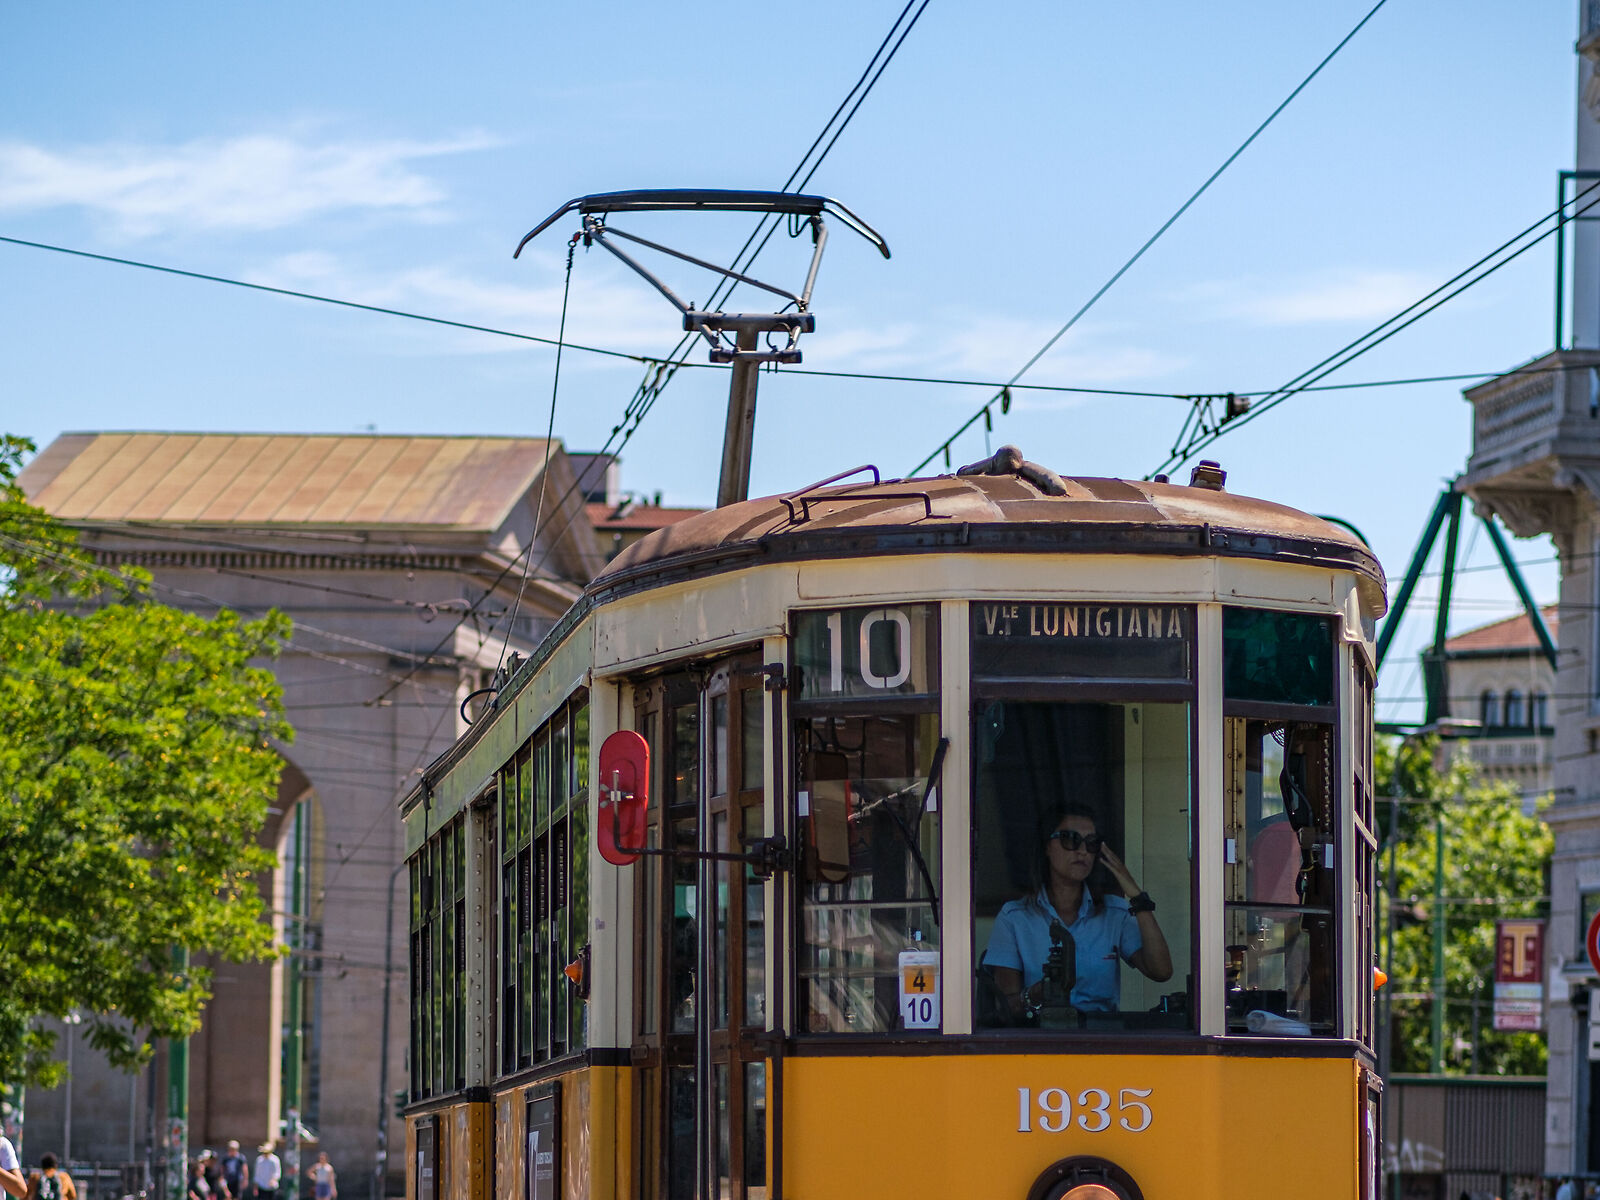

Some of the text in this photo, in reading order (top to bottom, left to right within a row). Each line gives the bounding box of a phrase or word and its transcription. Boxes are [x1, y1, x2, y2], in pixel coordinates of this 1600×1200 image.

[1030, 606, 1182, 638] LUNIGIANA
[827, 608, 911, 692] 10
[1502, 924, 1539, 977] T
[913, 967, 926, 992] 4
[907, 997, 932, 1022] 10
[1017, 1087, 1153, 1132] 1935
